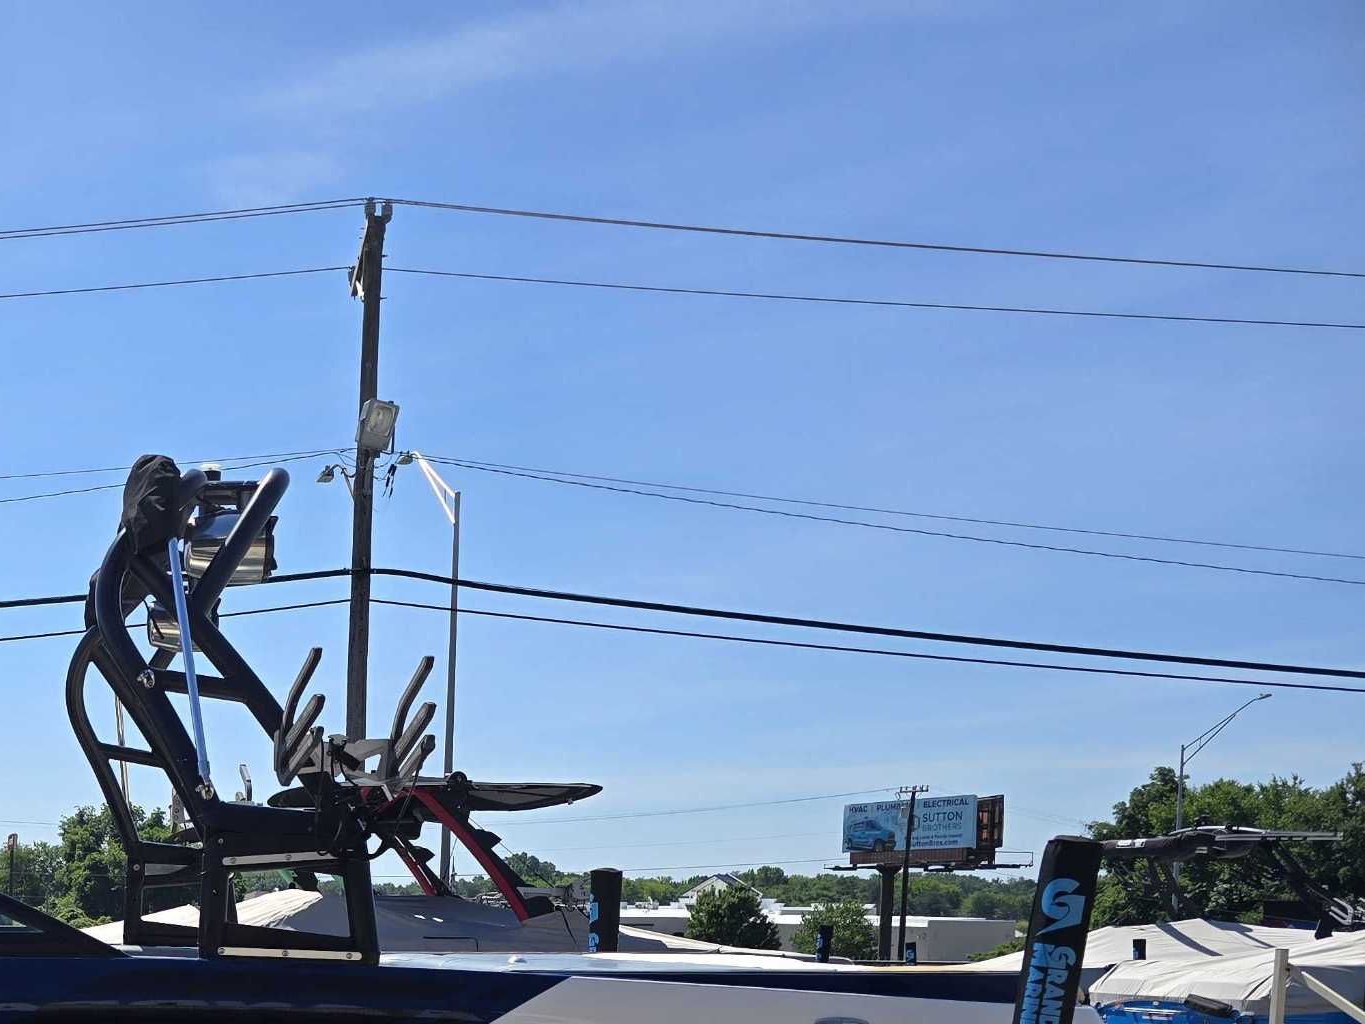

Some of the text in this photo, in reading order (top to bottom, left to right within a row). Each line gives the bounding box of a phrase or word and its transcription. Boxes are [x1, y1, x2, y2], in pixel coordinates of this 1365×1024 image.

[849, 805, 868, 813] HVAC
[923, 799, 970, 809] ELECTRICAL
[922, 811, 963, 823] SUTTON
